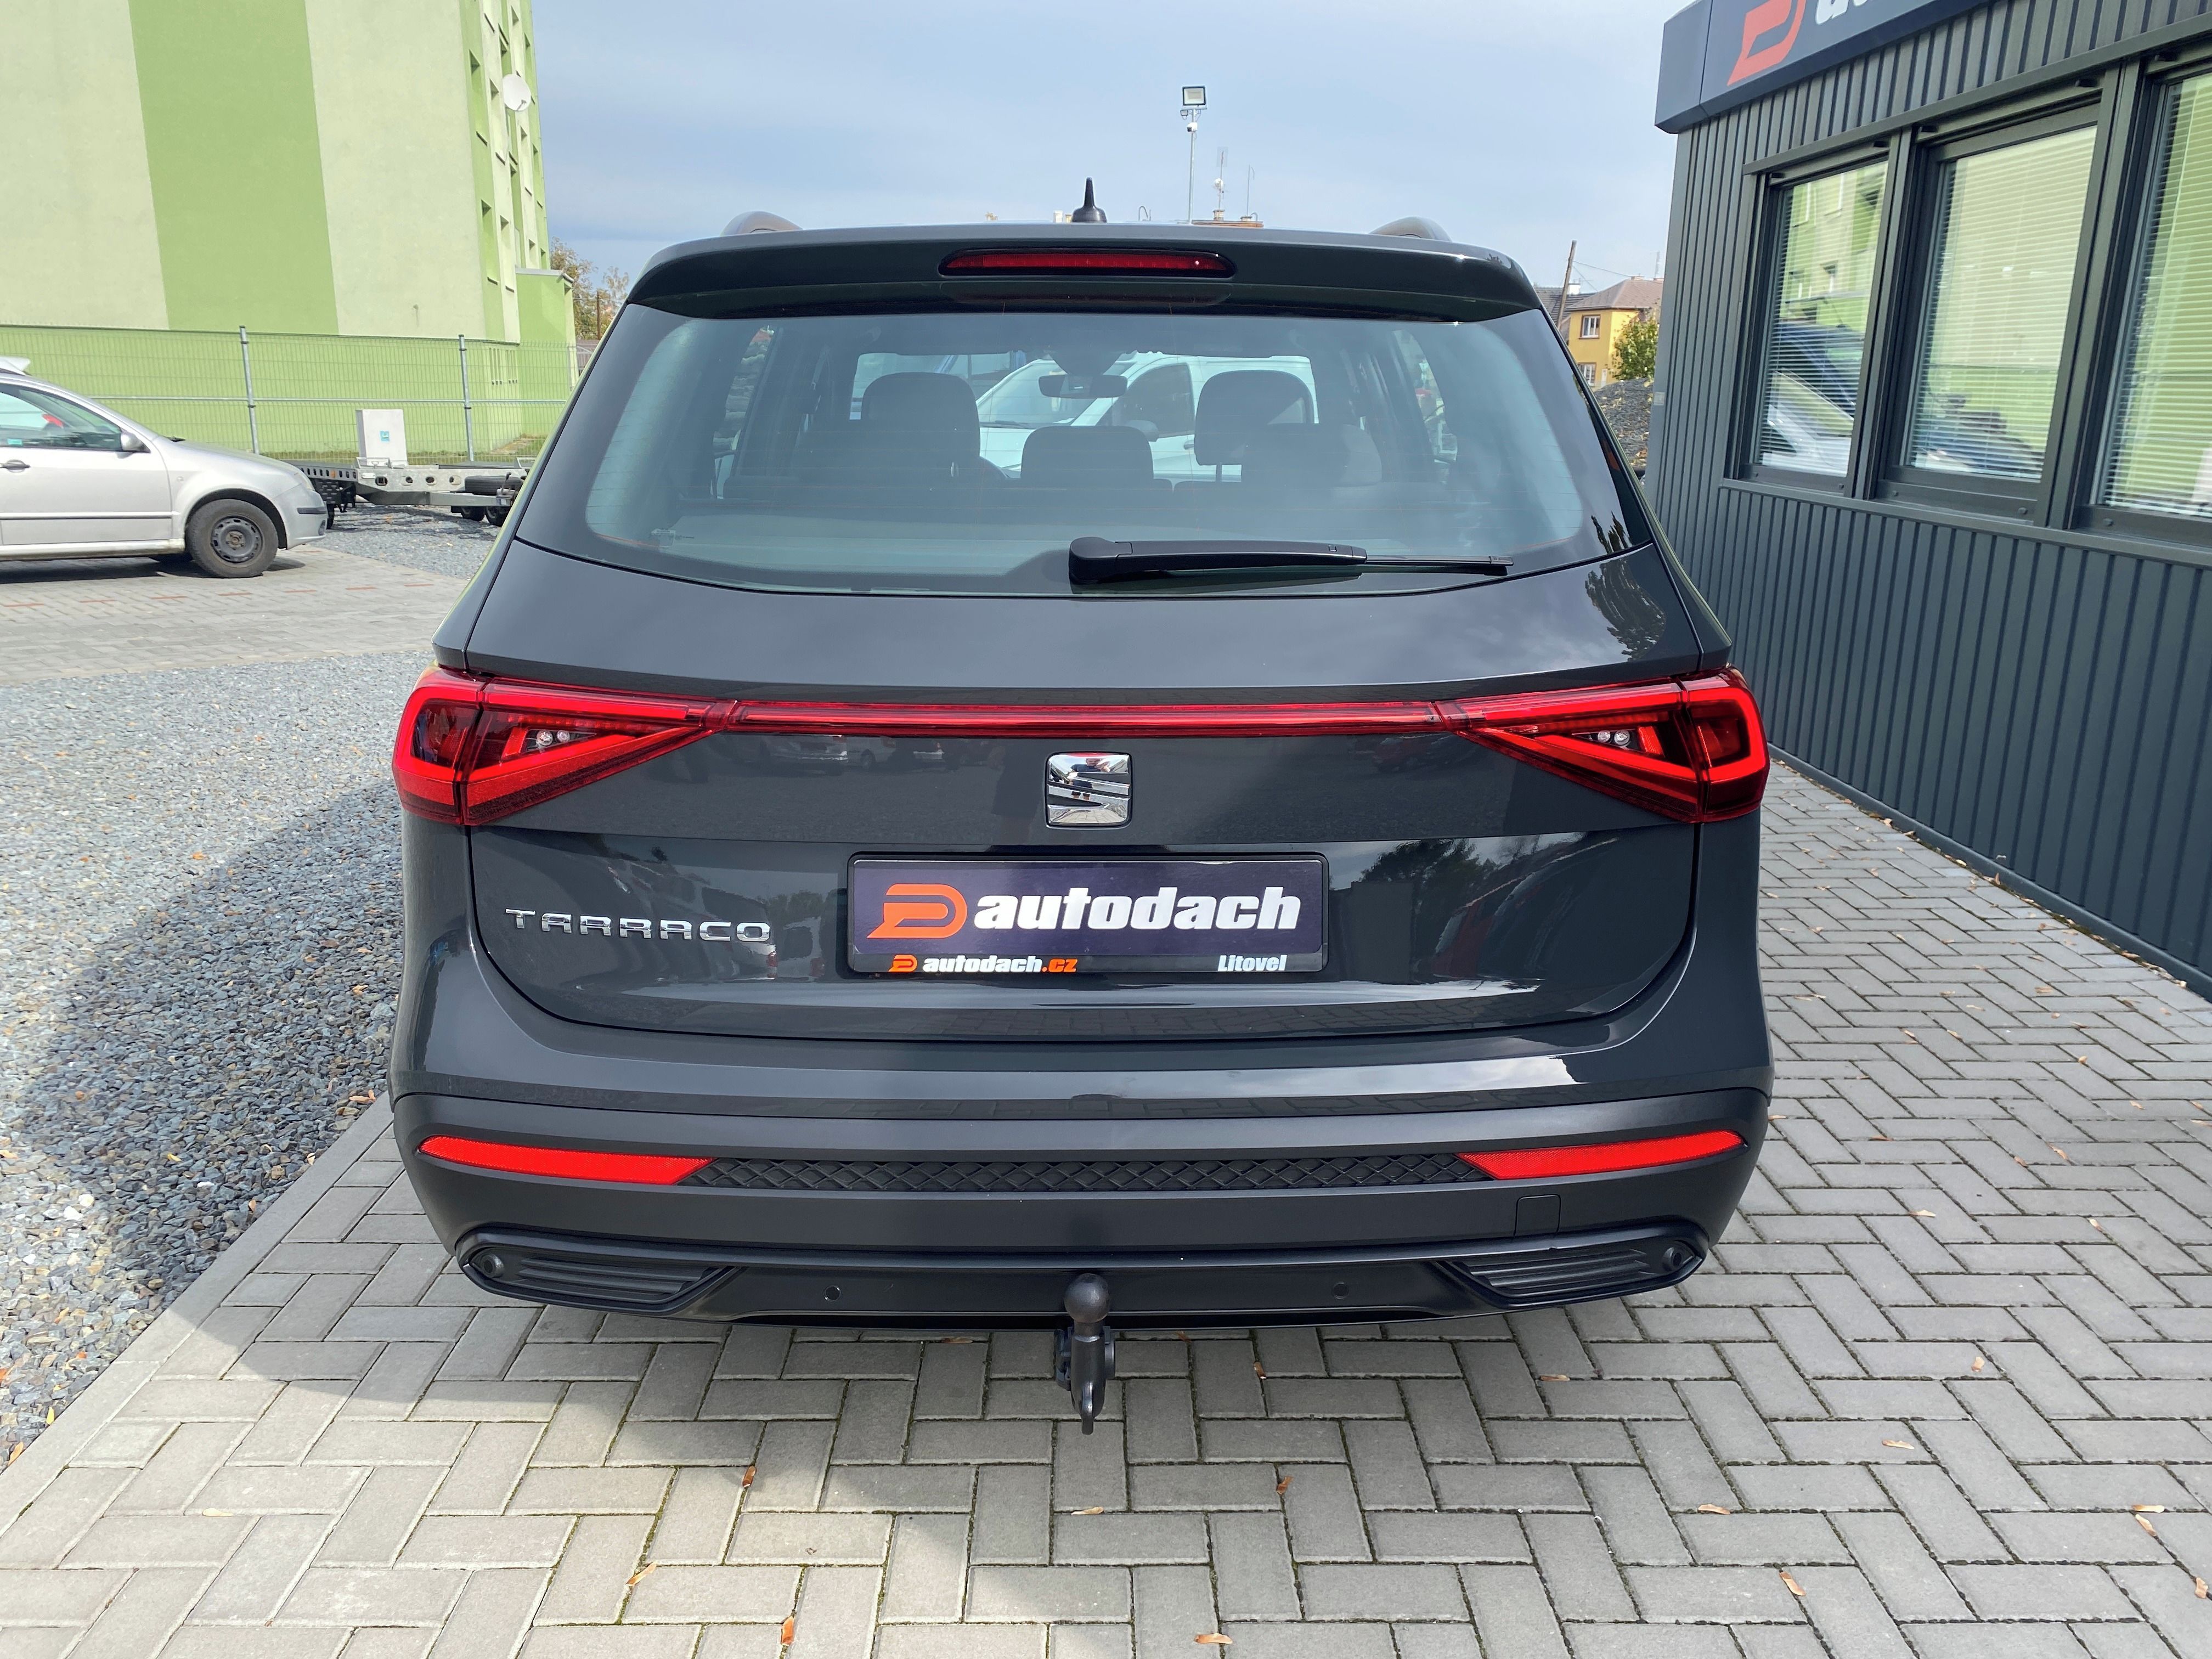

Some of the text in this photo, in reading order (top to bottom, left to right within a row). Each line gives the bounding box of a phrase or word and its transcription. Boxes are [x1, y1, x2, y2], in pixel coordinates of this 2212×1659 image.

[974, 886, 1301, 930] autodach
[504, 908, 771, 943] TARRACO
[923, 955, 1078, 973] autodach.cz
[1217, 954, 1288, 972] Litovel
